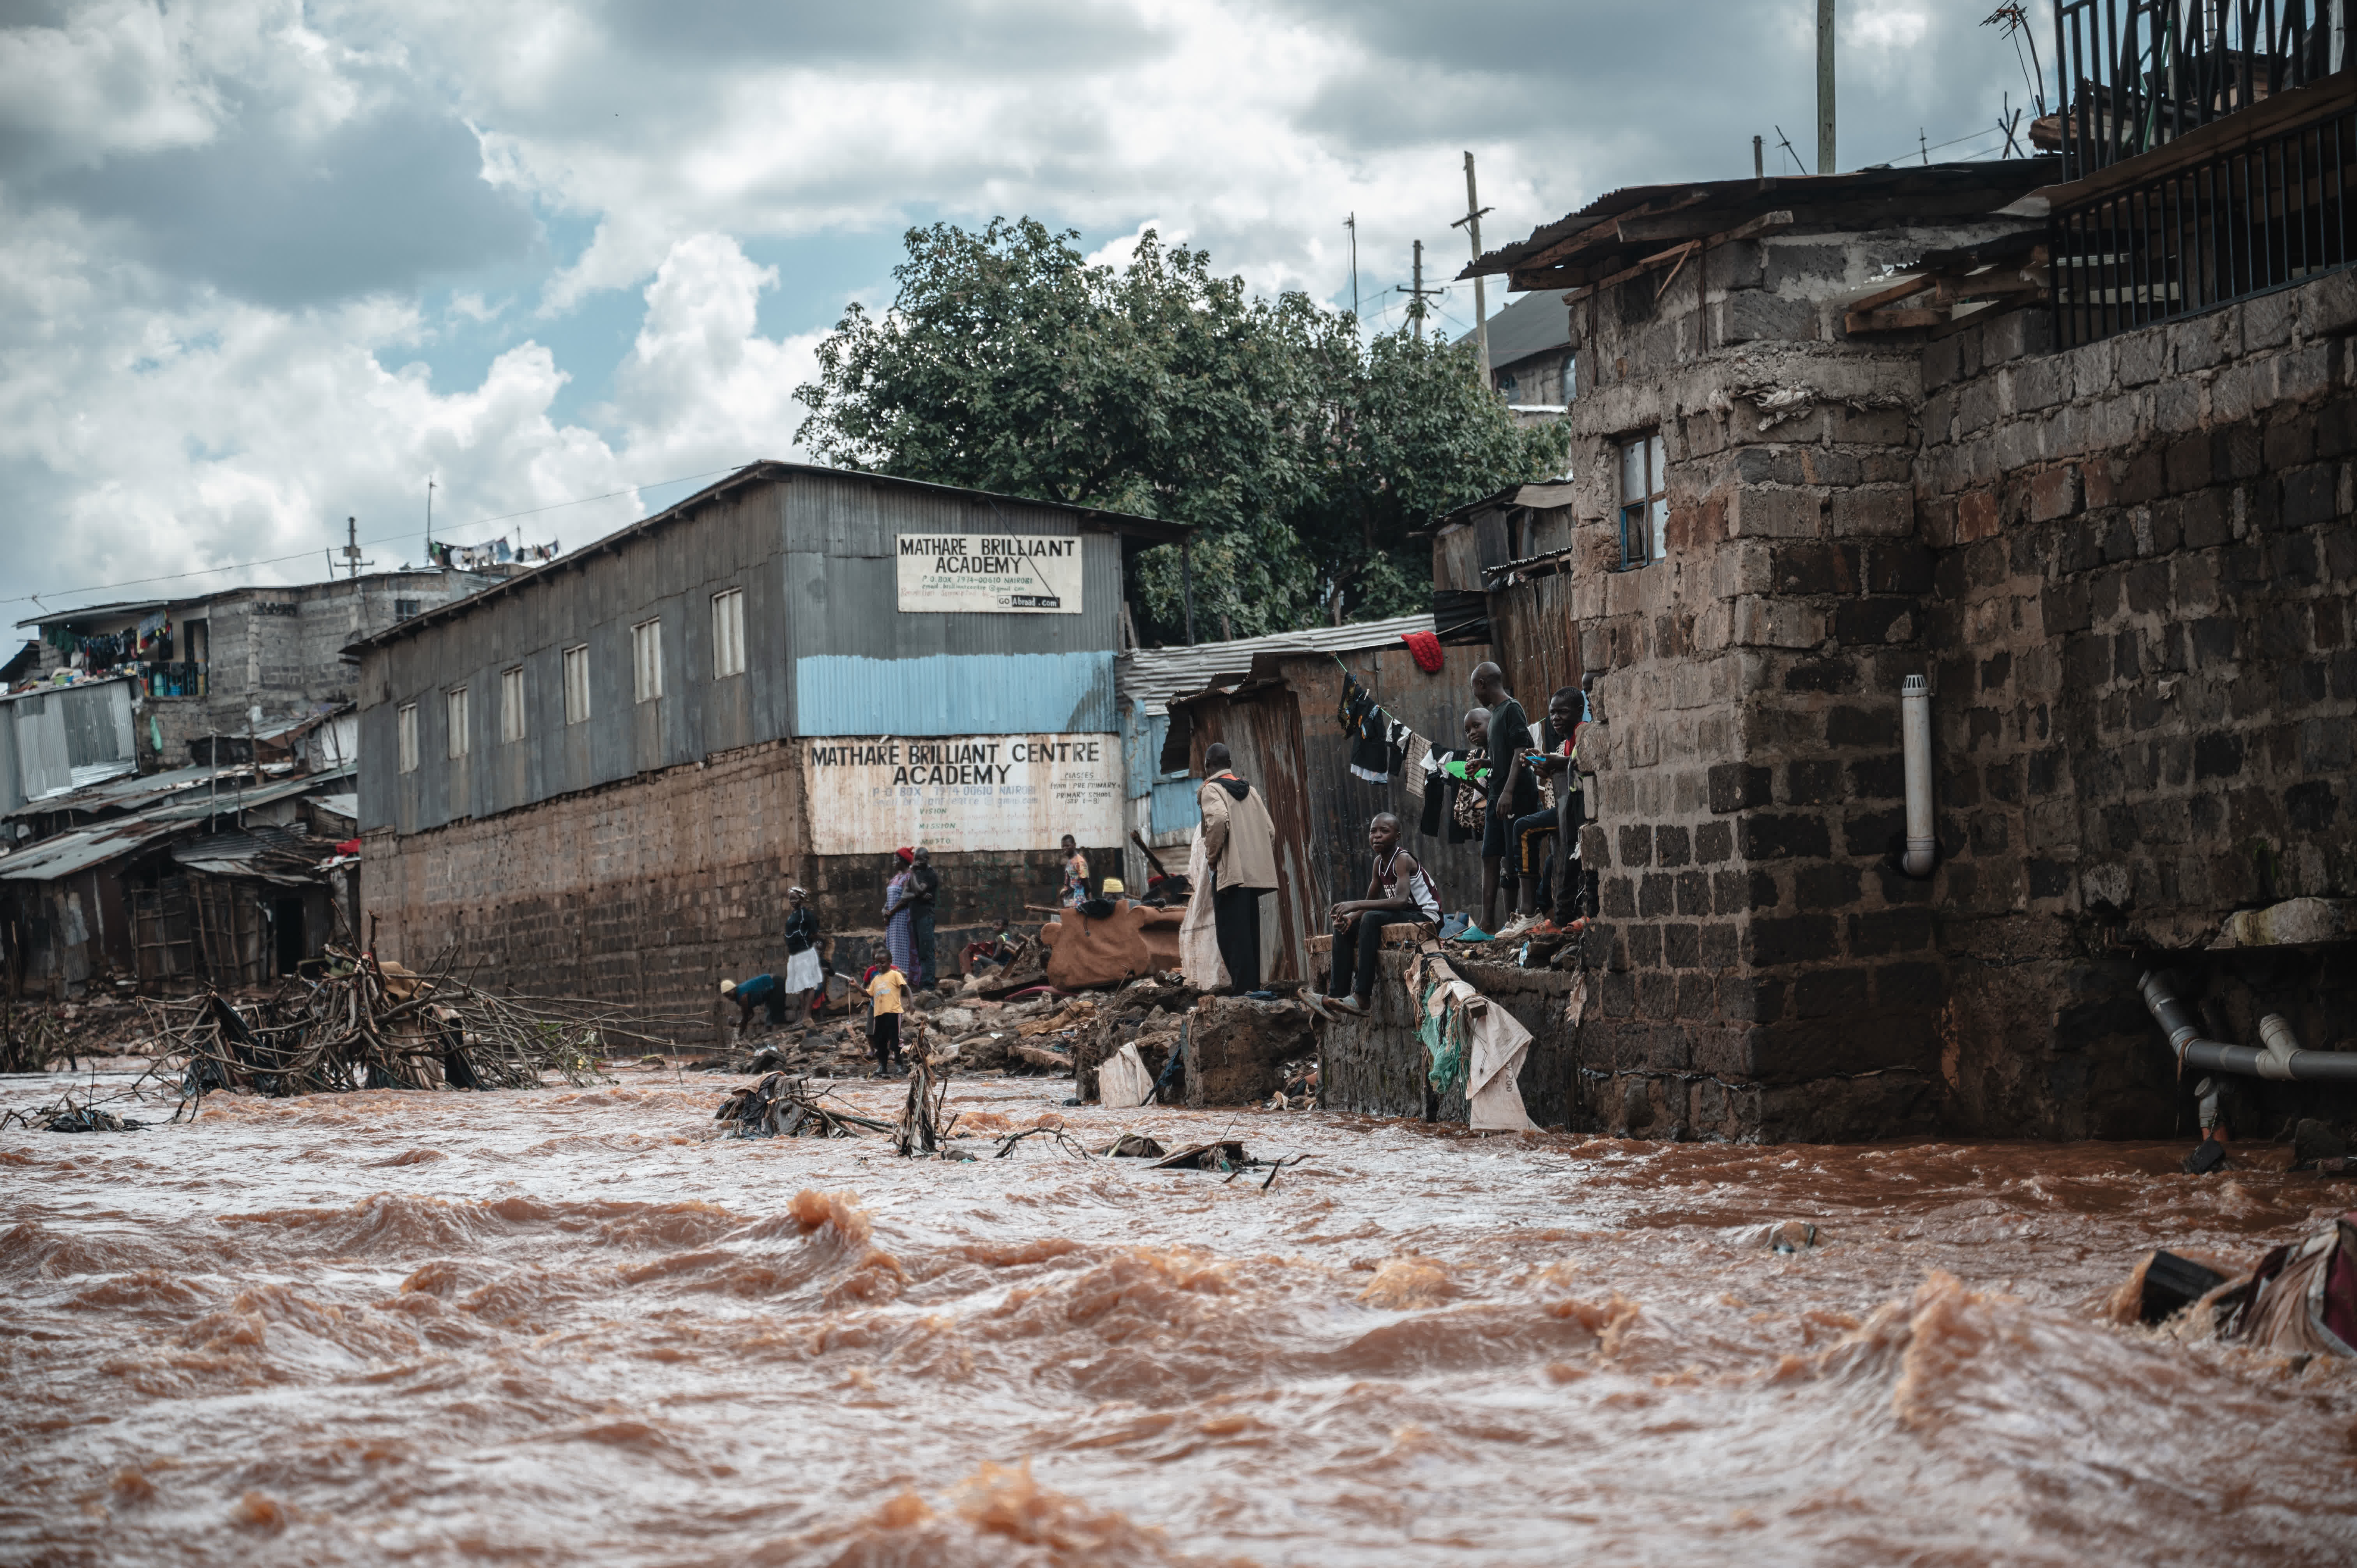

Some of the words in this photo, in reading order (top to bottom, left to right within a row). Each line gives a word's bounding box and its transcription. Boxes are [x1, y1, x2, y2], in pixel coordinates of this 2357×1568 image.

[900, 539, 966, 555] MATHARE
[981, 539, 1074, 556] BRILLIANT
[935, 556, 1022, 574] ACADEMY
[811, 746, 899, 766] MATHARE
[909, 744, 1000, 765] BRILLIANT
[1012, 742, 1099, 763] CENTRE
[892, 765, 1012, 785] ACADEMY
[899, 787, 921, 796] BOX
[934, 786, 959, 796] 7974
[963, 786, 993, 795] 00610
[999, 785, 1035, 795] NAIROBI
